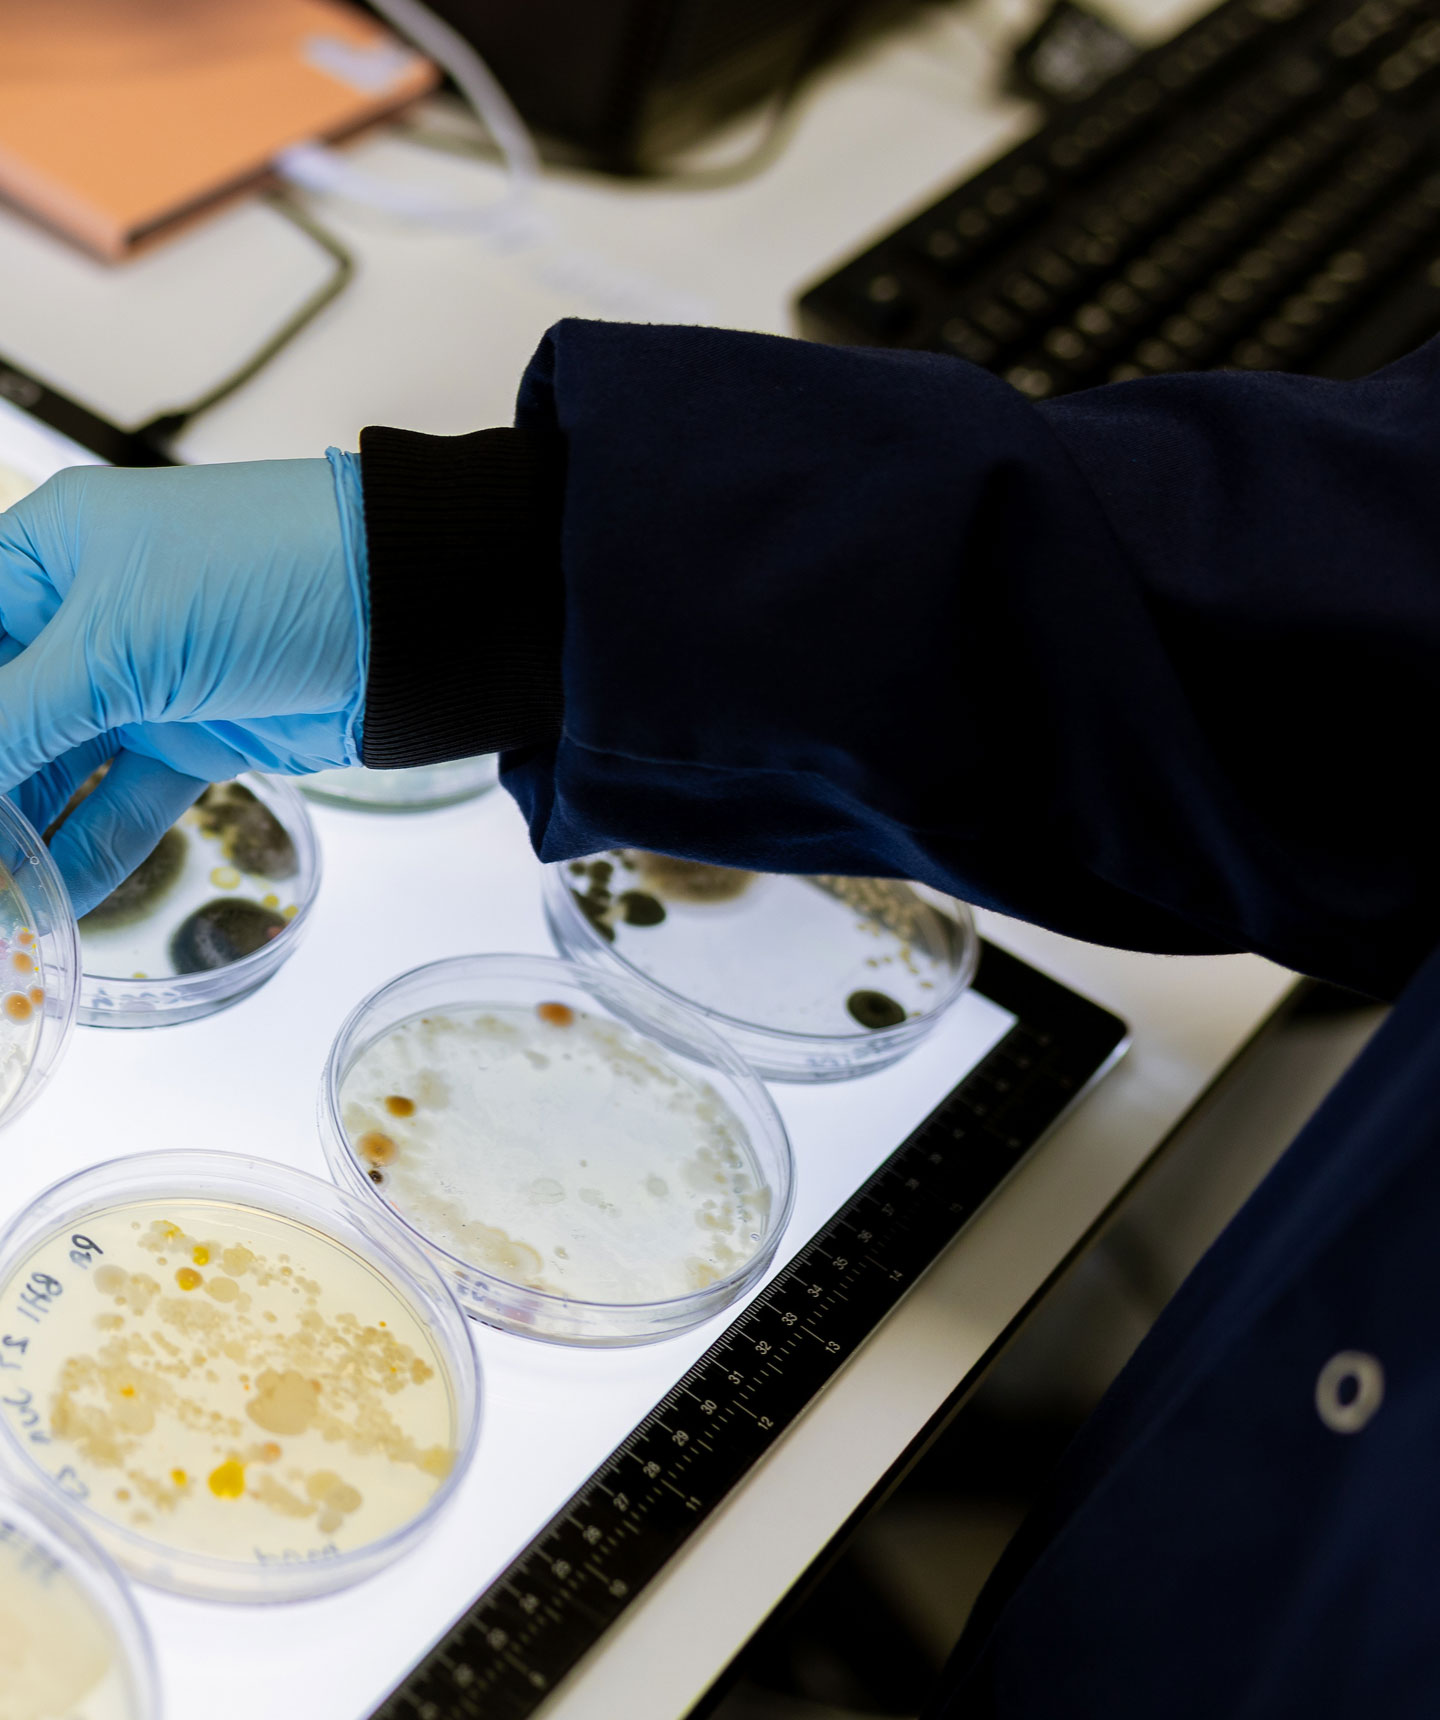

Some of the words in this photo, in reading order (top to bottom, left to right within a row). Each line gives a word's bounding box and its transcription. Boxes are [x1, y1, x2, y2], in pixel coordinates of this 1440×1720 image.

[613, 1492, 630, 1512] 27
[643, 1461, 661, 1479] 28
[671, 1429, 689, 1447] 29
[700, 1399, 718, 1416] 30
[727, 1369, 745, 1385] 31
[754, 1340, 772, 1355] 32
[781, 1311, 798, 1326] 33
[807, 1283, 824, 1298] 34
[832, 1256, 849, 1270] 35
[857, 1229, 873, 1243] 36
[685, 1495, 703, 1512] 11
[757, 1415, 774, 1431] 12
[825, 1340, 841, 1353] 13
[889, 1269, 904, 1282] 14
